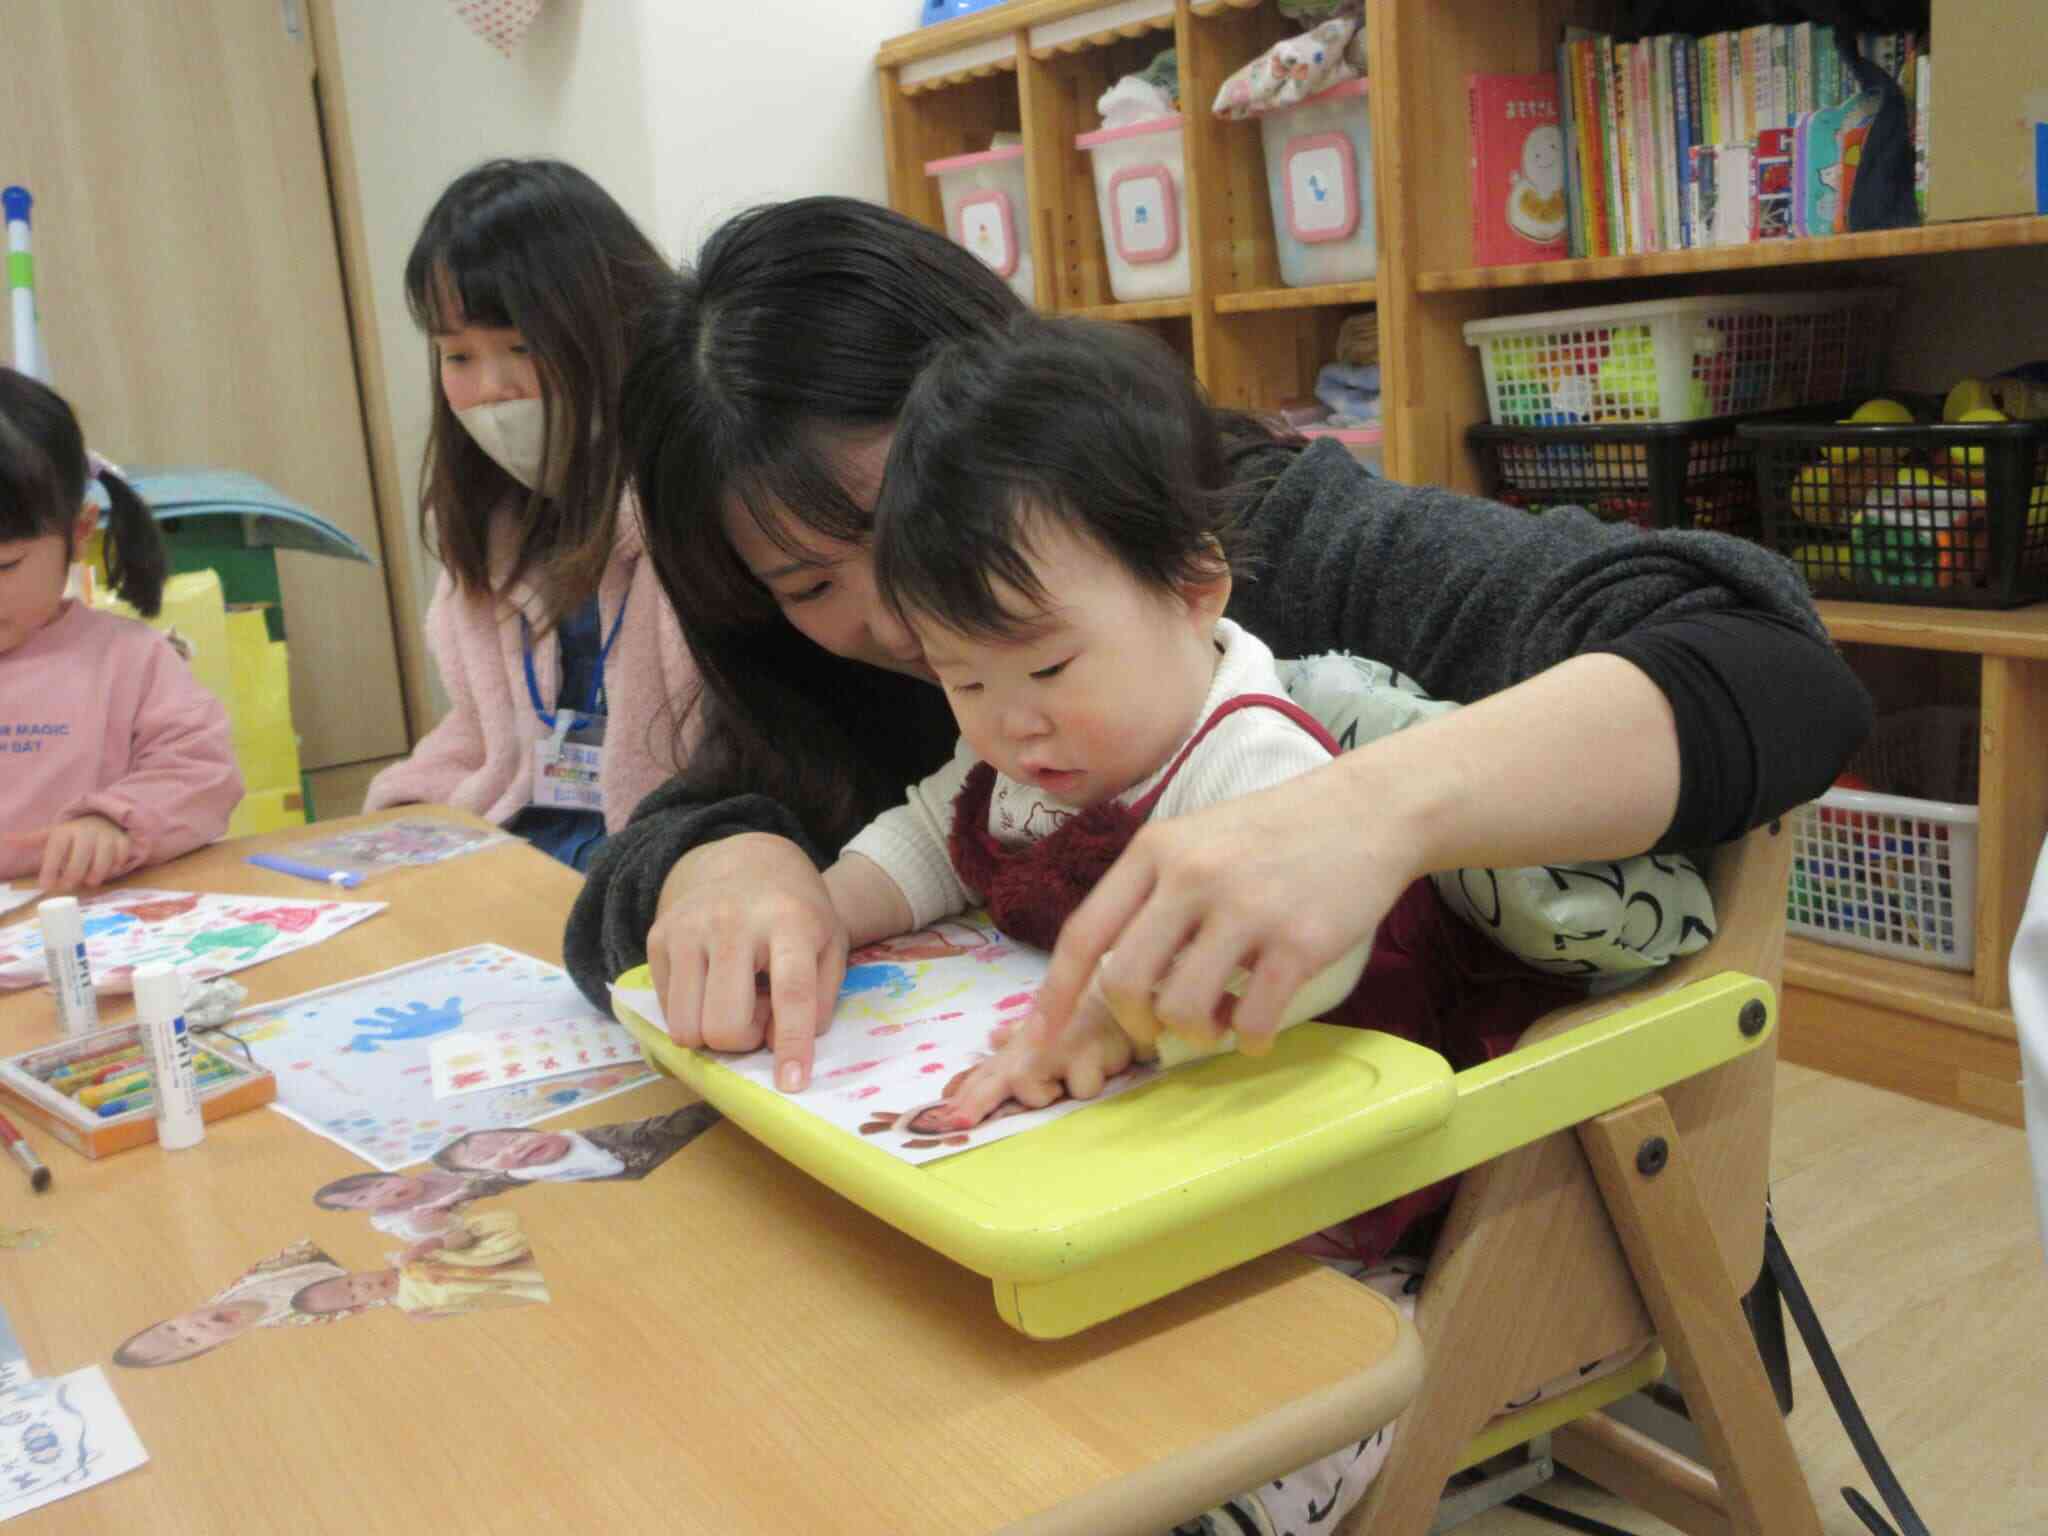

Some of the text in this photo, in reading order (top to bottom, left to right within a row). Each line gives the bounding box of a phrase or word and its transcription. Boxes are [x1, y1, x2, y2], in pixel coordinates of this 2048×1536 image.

[16, 723, 71, 737] MAGIC
[77, 958, 92, 988] PIT
[176, 1035, 193, 1069] PIT
